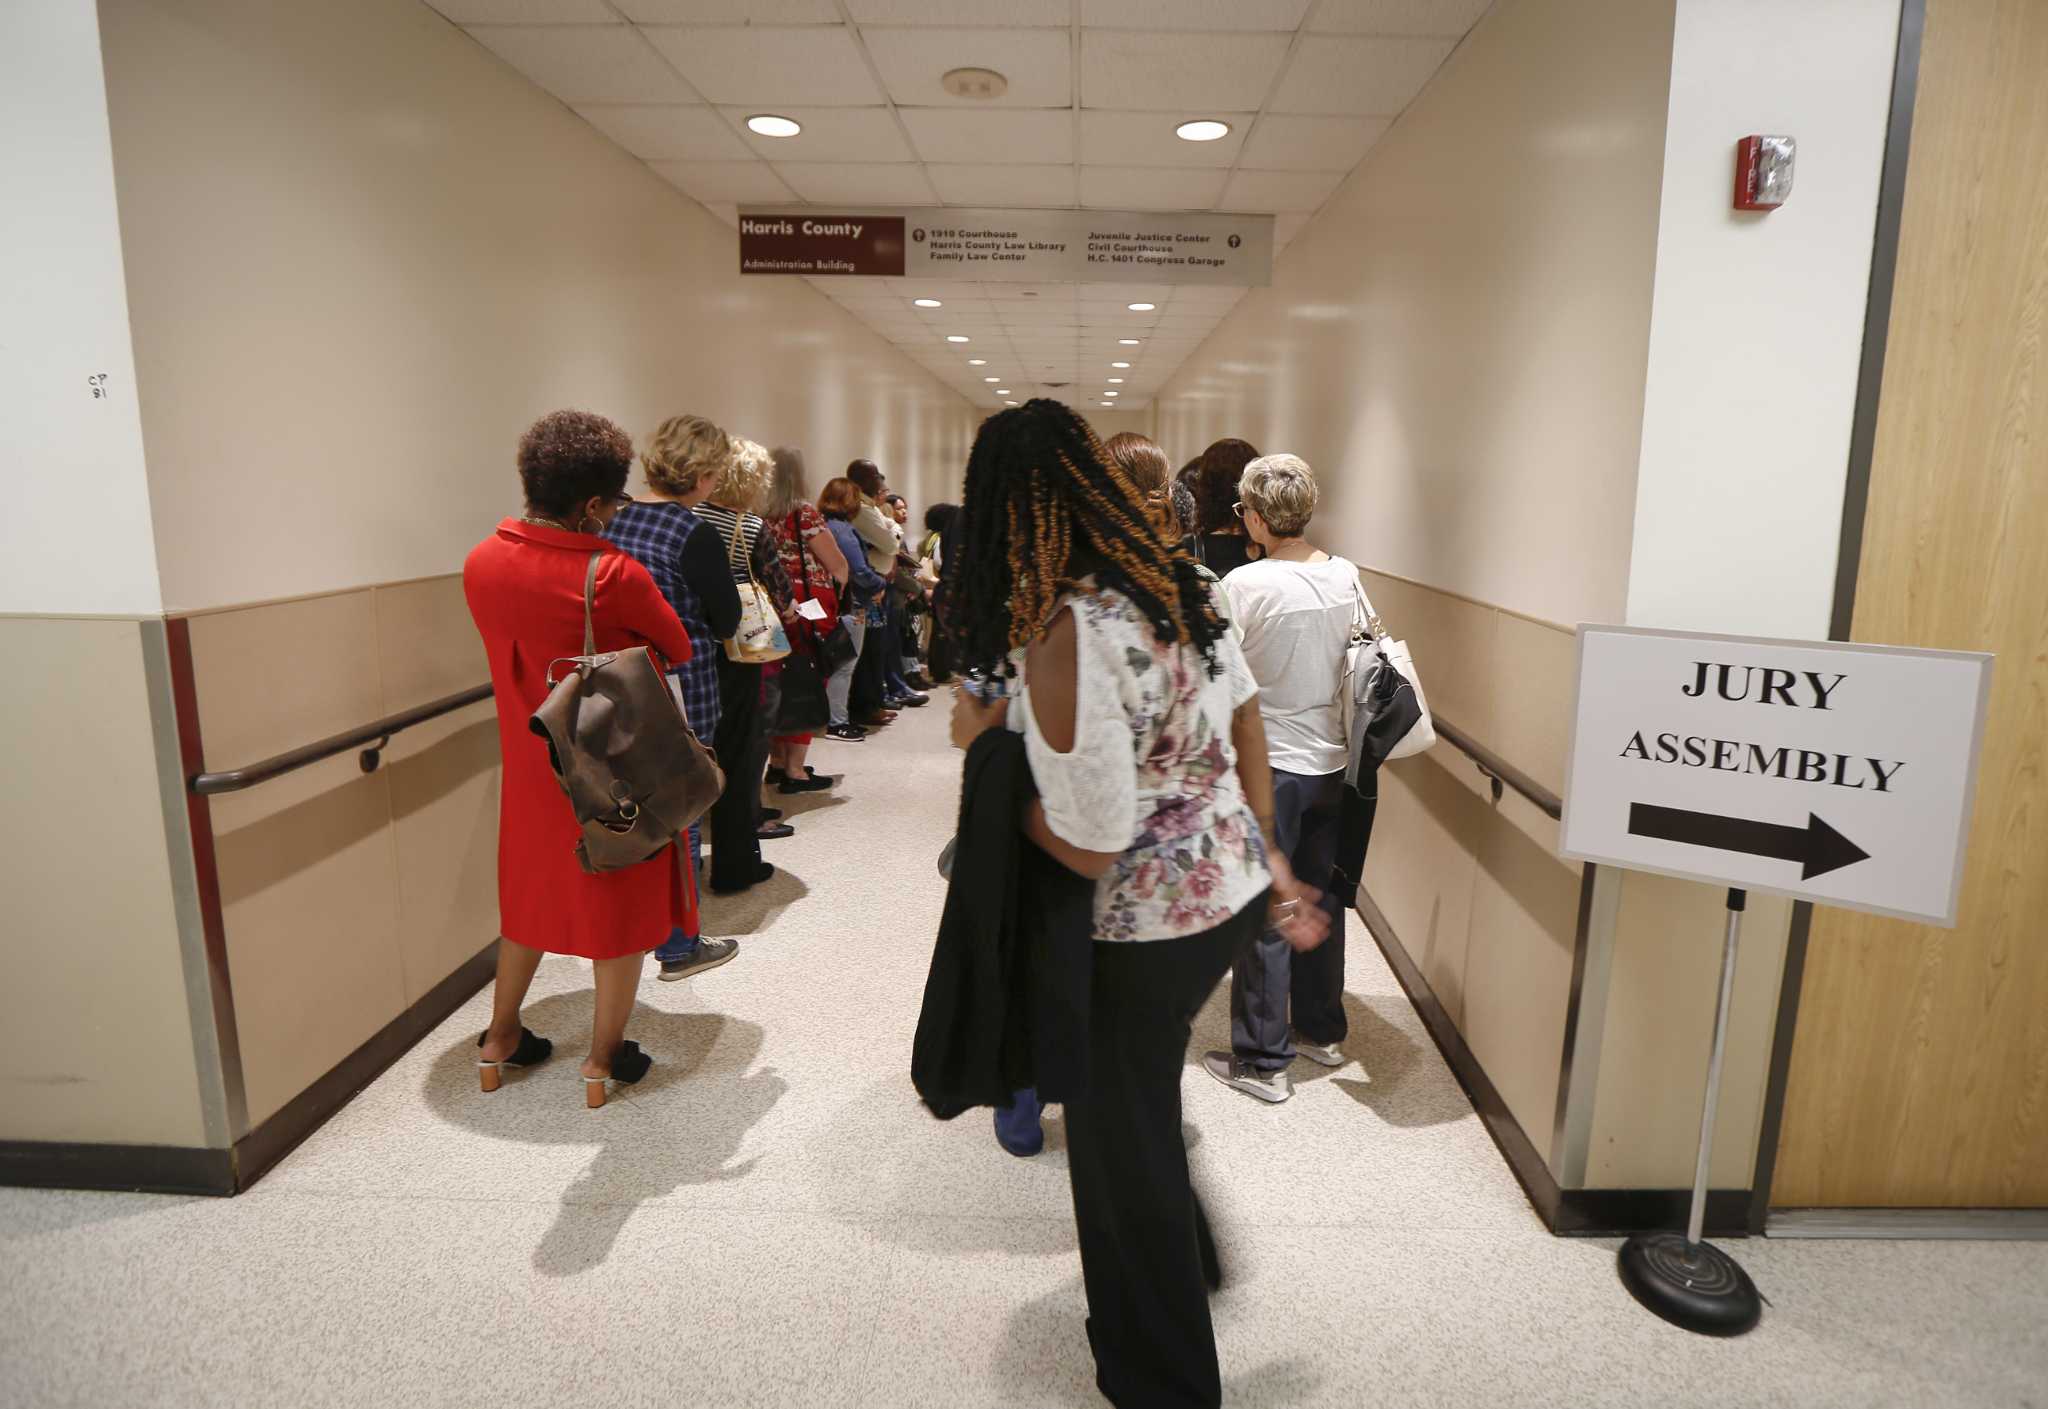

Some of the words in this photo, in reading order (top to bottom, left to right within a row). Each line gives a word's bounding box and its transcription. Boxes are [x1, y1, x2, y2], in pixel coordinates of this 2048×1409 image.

[741, 220, 794, 235] Harris
[802, 220, 862, 239] County
[958, 229, 1018, 238] Courthouse
[1088, 231, 1131, 240] Juvenile
[1135, 232, 1172, 241] Justice
[1175, 234, 1210, 242] Center
[930, 241, 962, 249] Harris
[965, 241, 1000, 251] County
[1004, 241, 1025, 249] Law
[1028, 241, 1066, 252] Library
[1088, 242, 1111, 251] Civil
[1113, 242, 1173, 252] Courthouse
[930, 251, 964, 262] Family
[967, 252, 988, 260] Law
[991, 252, 1025, 261] Center
[1111, 254, 1133, 263] 1401
[1136, 255, 1185, 266] Congress
[1187, 256, 1225, 267] Garage
[743, 259, 813, 270] Administration
[816, 259, 855, 272] Building
[1681, 661, 1847, 711] JURY
[1619, 729, 1906, 793] ASSEMBLY
